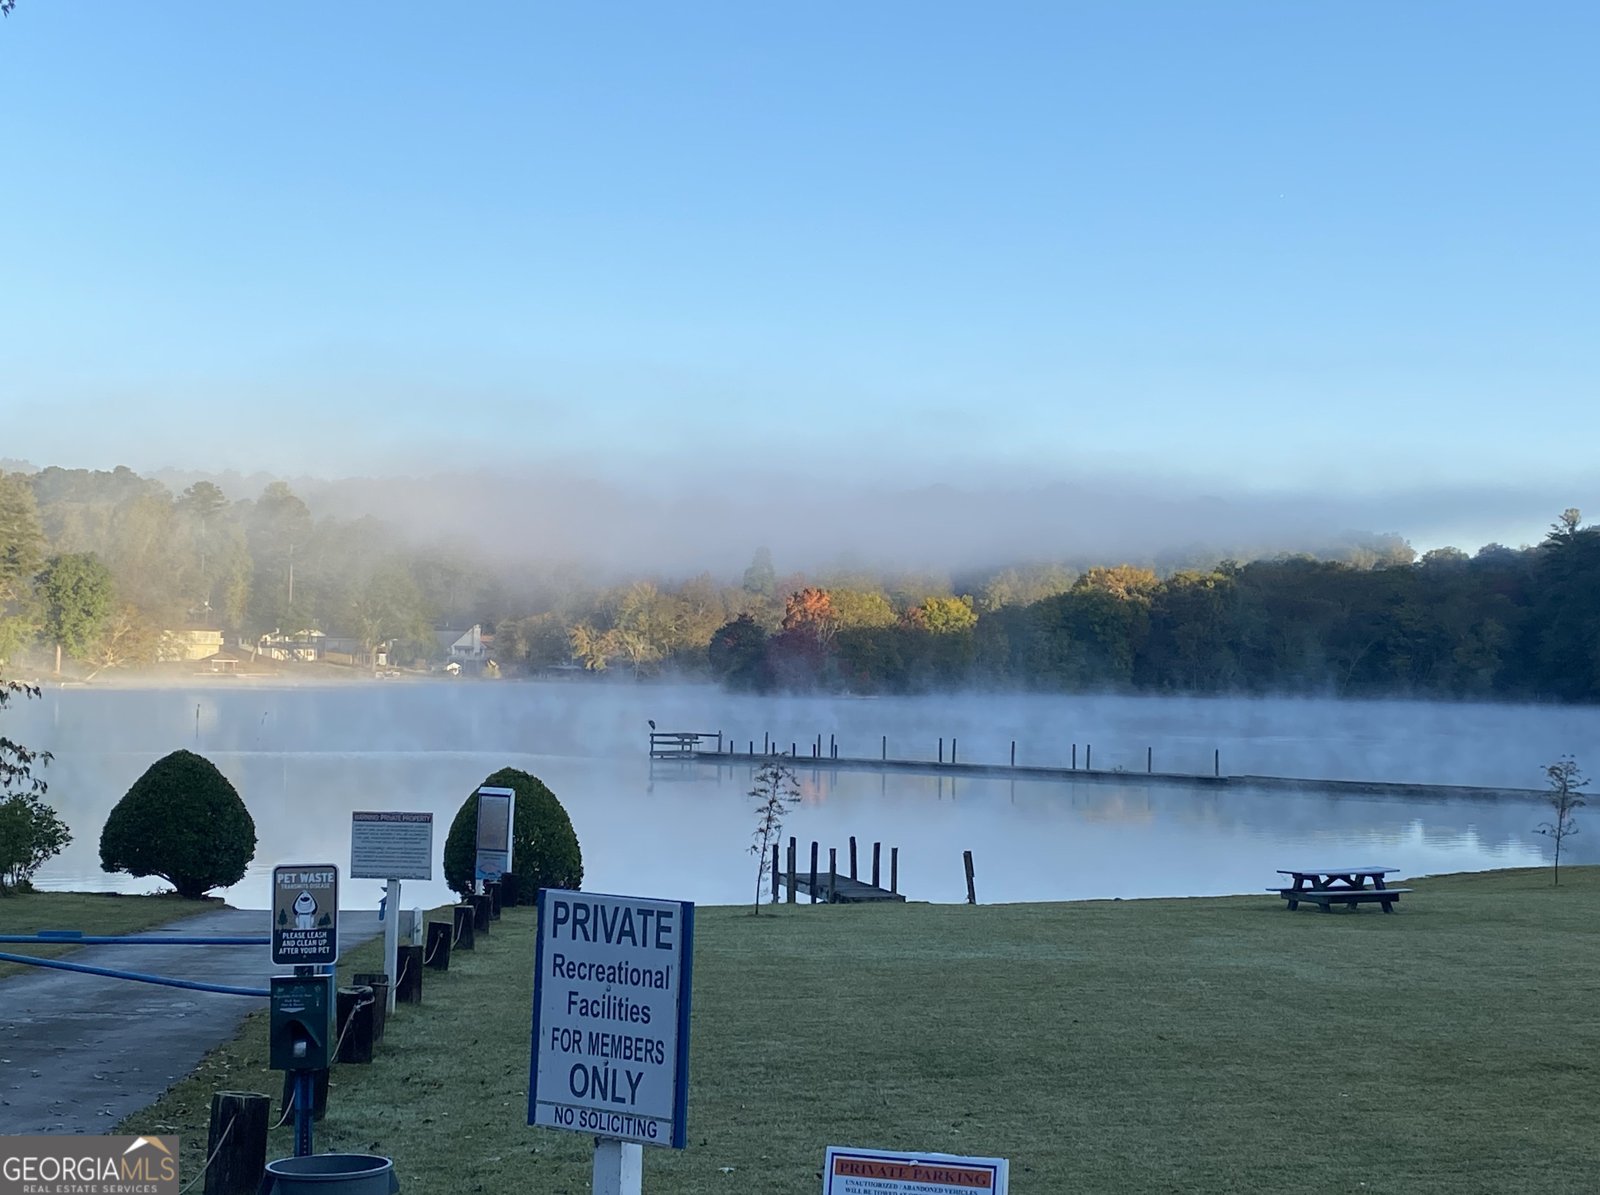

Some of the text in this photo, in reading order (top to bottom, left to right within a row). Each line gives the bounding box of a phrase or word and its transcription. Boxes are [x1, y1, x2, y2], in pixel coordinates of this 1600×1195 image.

[277, 872, 334, 883] PET WASTE
[552, 901, 673, 950] PRIVATE
[552, 953, 670, 990] Recreational
[567, 991, 651, 1024] Facilities
[551, 1027, 664, 1065] FOR MEMBERS
[569, 1063, 644, 1105] ONLY
[554, 1107, 657, 1138] NO SOLICITING
[840, 1162, 987, 1185] PRIVATE PARKING
[845, 1180, 898, 1190] UNAUTHORIZED
[903, 1184, 943, 1193] ABANDONED
